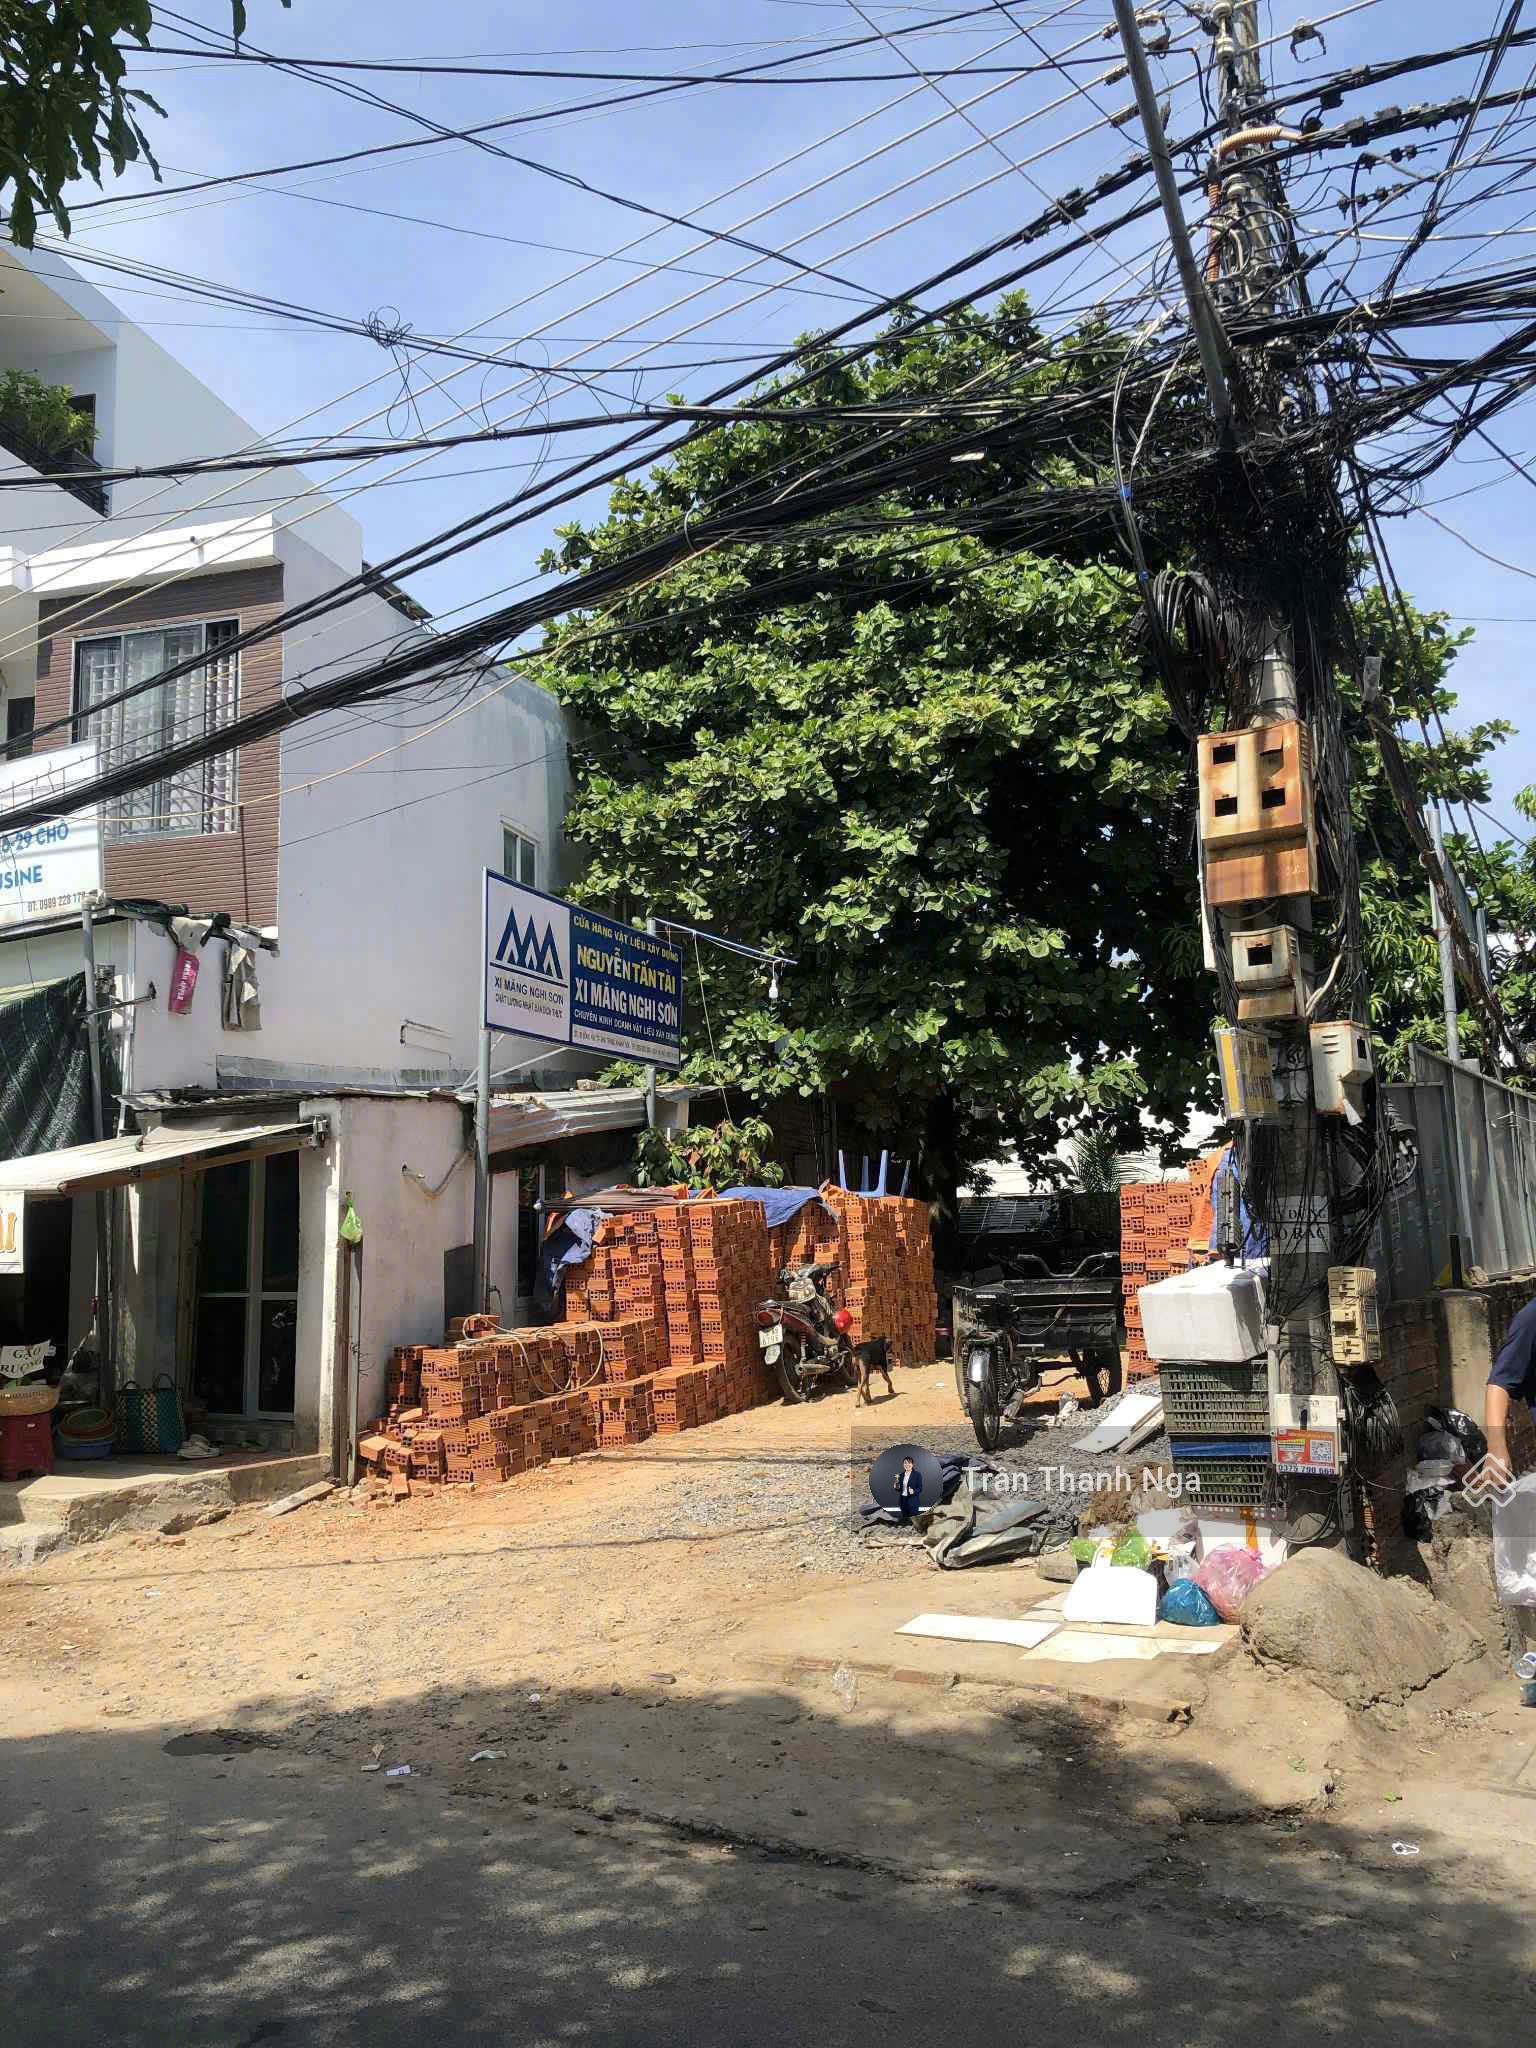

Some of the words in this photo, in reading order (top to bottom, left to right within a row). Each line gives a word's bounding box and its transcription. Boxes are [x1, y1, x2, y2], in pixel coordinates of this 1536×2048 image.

[0, 864, 43, 890] SINE
[576, 943, 631, 981] NGUYỄN
[632, 960, 656, 989] TẤN
[657, 969, 676, 995] TÀI
[494, 976, 503, 988] XI
[504, 979, 528, 995] MĂNG
[529, 985, 547, 1000] NGHI
[548, 990, 564, 1006] SƠN
[575, 977, 589, 1002] XI
[591, 982, 627, 1016] MĂNG
[628, 994, 656, 1021] NGHI
[657, 1002, 678, 1028] SƠN
